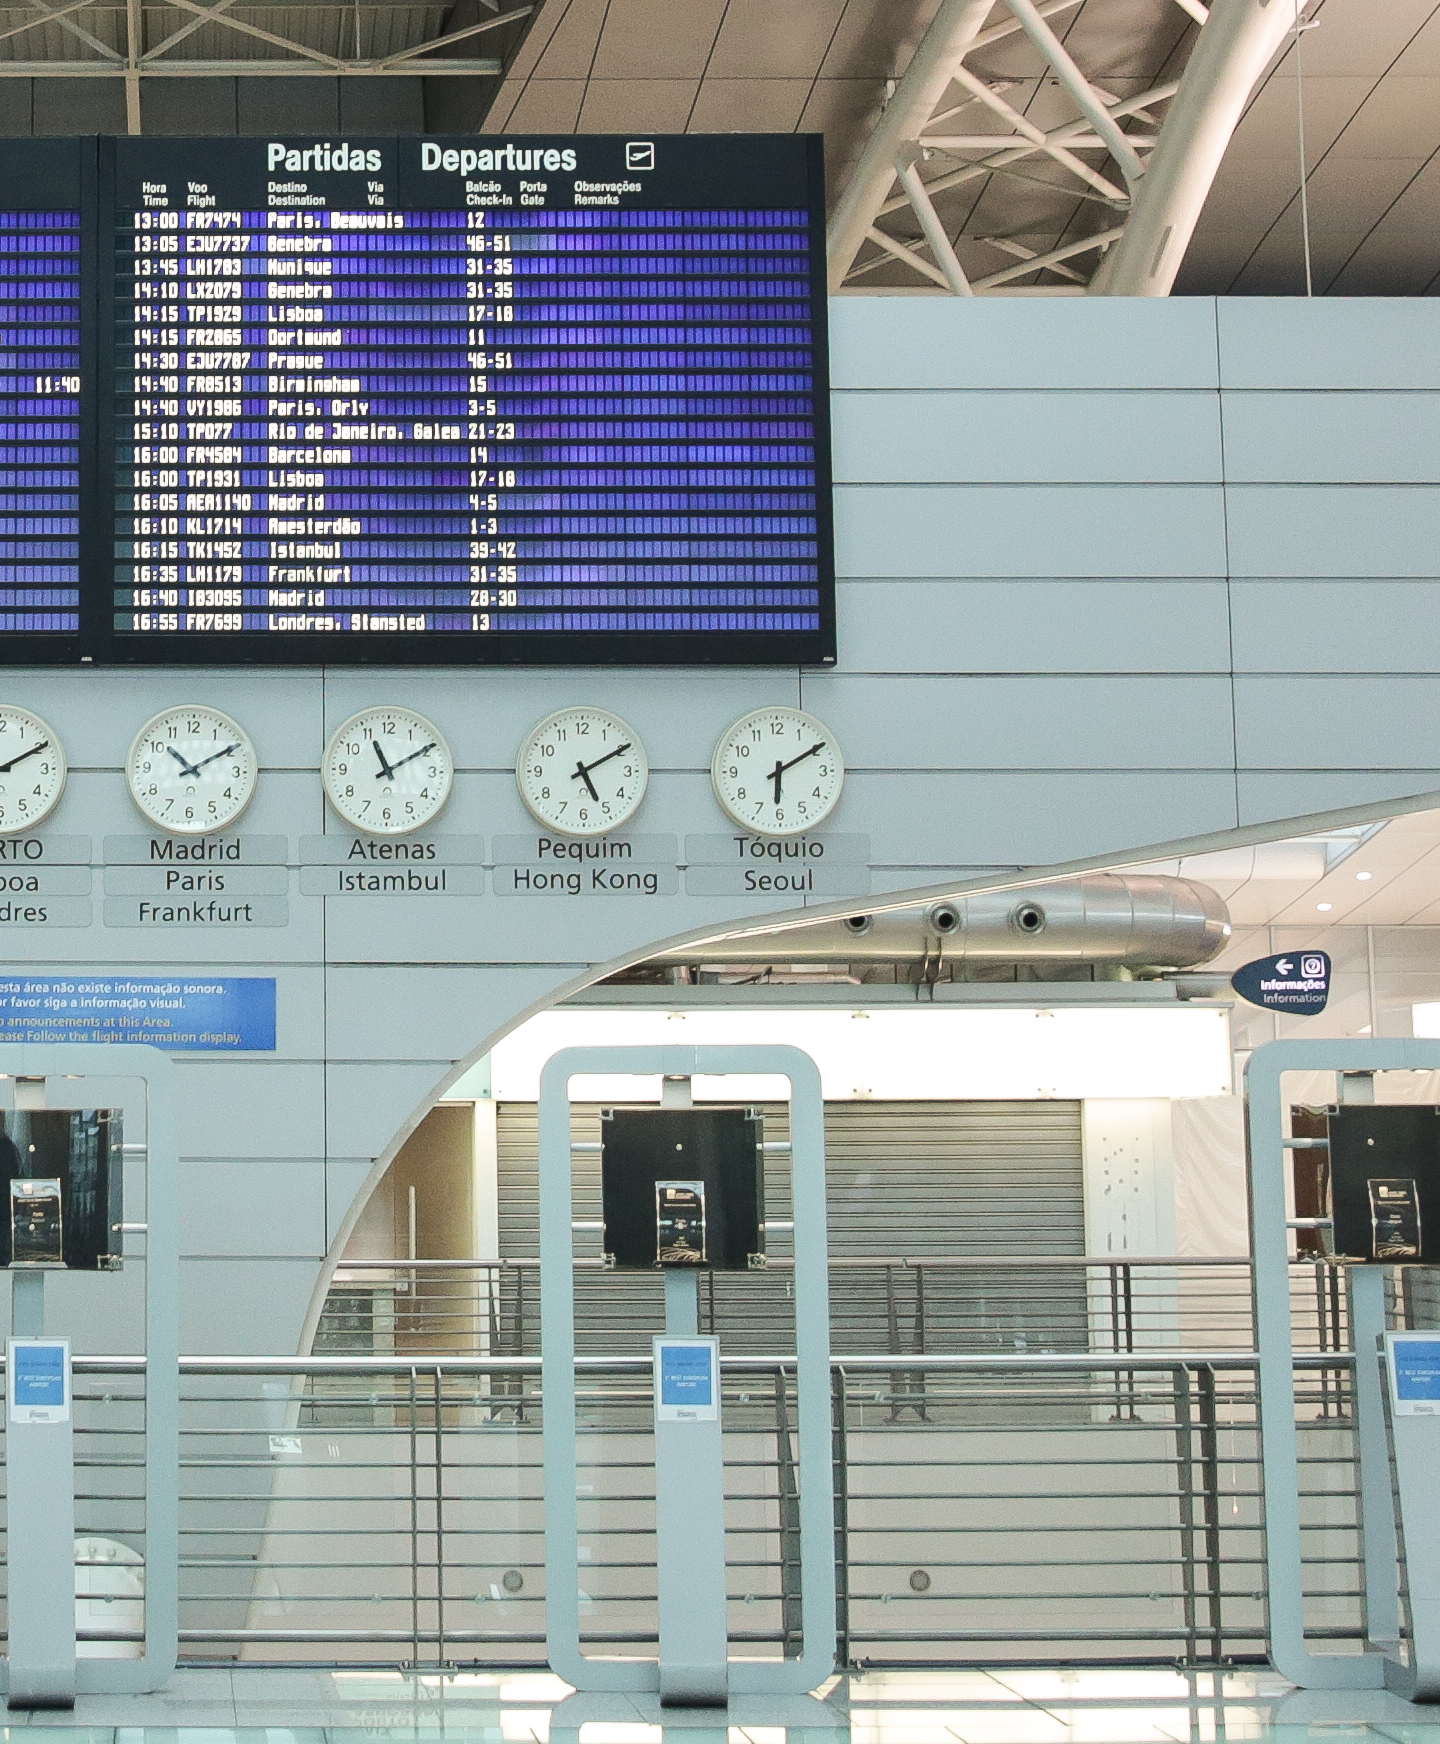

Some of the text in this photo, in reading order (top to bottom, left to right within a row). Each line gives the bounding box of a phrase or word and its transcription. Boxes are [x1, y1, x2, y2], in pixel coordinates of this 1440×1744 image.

[267, 142, 577, 177] Partidas Departures
[142, 181, 167, 193] Hora
[187, 181, 208, 193] Voo
[267, 181, 307, 193] Destino
[367, 181, 385, 193] Via
[519, 181, 548, 193] Porta
[142, 193, 621, 208] Time Flight Destination Via Check-In Gate Remarks
[134, 211, 179, 230] 13:00
[134, 258, 179, 276] 13:45
[134, 281, 179, 299] 14:10
[134, 328, 179, 346] 14:15
[134, 352, 179, 370] 14:30
[36, 376, 81, 394] 11:40
[133, 446, 179, 464] 16:00
[133, 517, 178, 535] 16:10
[133, 541, 341, 559] 16:15 Istanbul
[133, 565, 351, 583] 16:35 Frankfurt
[133, 589, 325, 607] 16:40 Madrid
[133, 613, 178, 631] 16:55
[150, 838, 241, 860] Madrid
[347, 838, 436, 860] Atenas
[538, 838, 632, 863] Pequim
[733, 837, 825, 863] Tóquio
[166, 869, 225, 891] Paris
[339, 869, 446, 891] Istambul
[514, 869, 658, 895] Hong Kong
[744, 869, 813, 891] Seoul
[139, 900, 253, 922] Frankfurt
[23, 981, 49, 993] área
[52, 982, 74, 993] não
[77, 982, 112, 993] existe
[114, 982, 181, 996] informação
[1260, 979, 1326, 992] Informações
[10, 996, 42, 1008] favor
[44, 996, 68, 1010] siga
[70, 999, 78, 1008] a
[81, 997, 147, 1010] informação
[1263, 993, 1326, 1004] Information
[8, 1016, 101, 1027] announcements
[102, 1018, 116, 1027] at
[119, 1016, 141, 1027] this
[27, 1030, 66, 1041] Follow
[69, 1031, 89, 1041] the
[92, 1031, 125, 1044] flight
[127, 1031, 197, 1042] information
